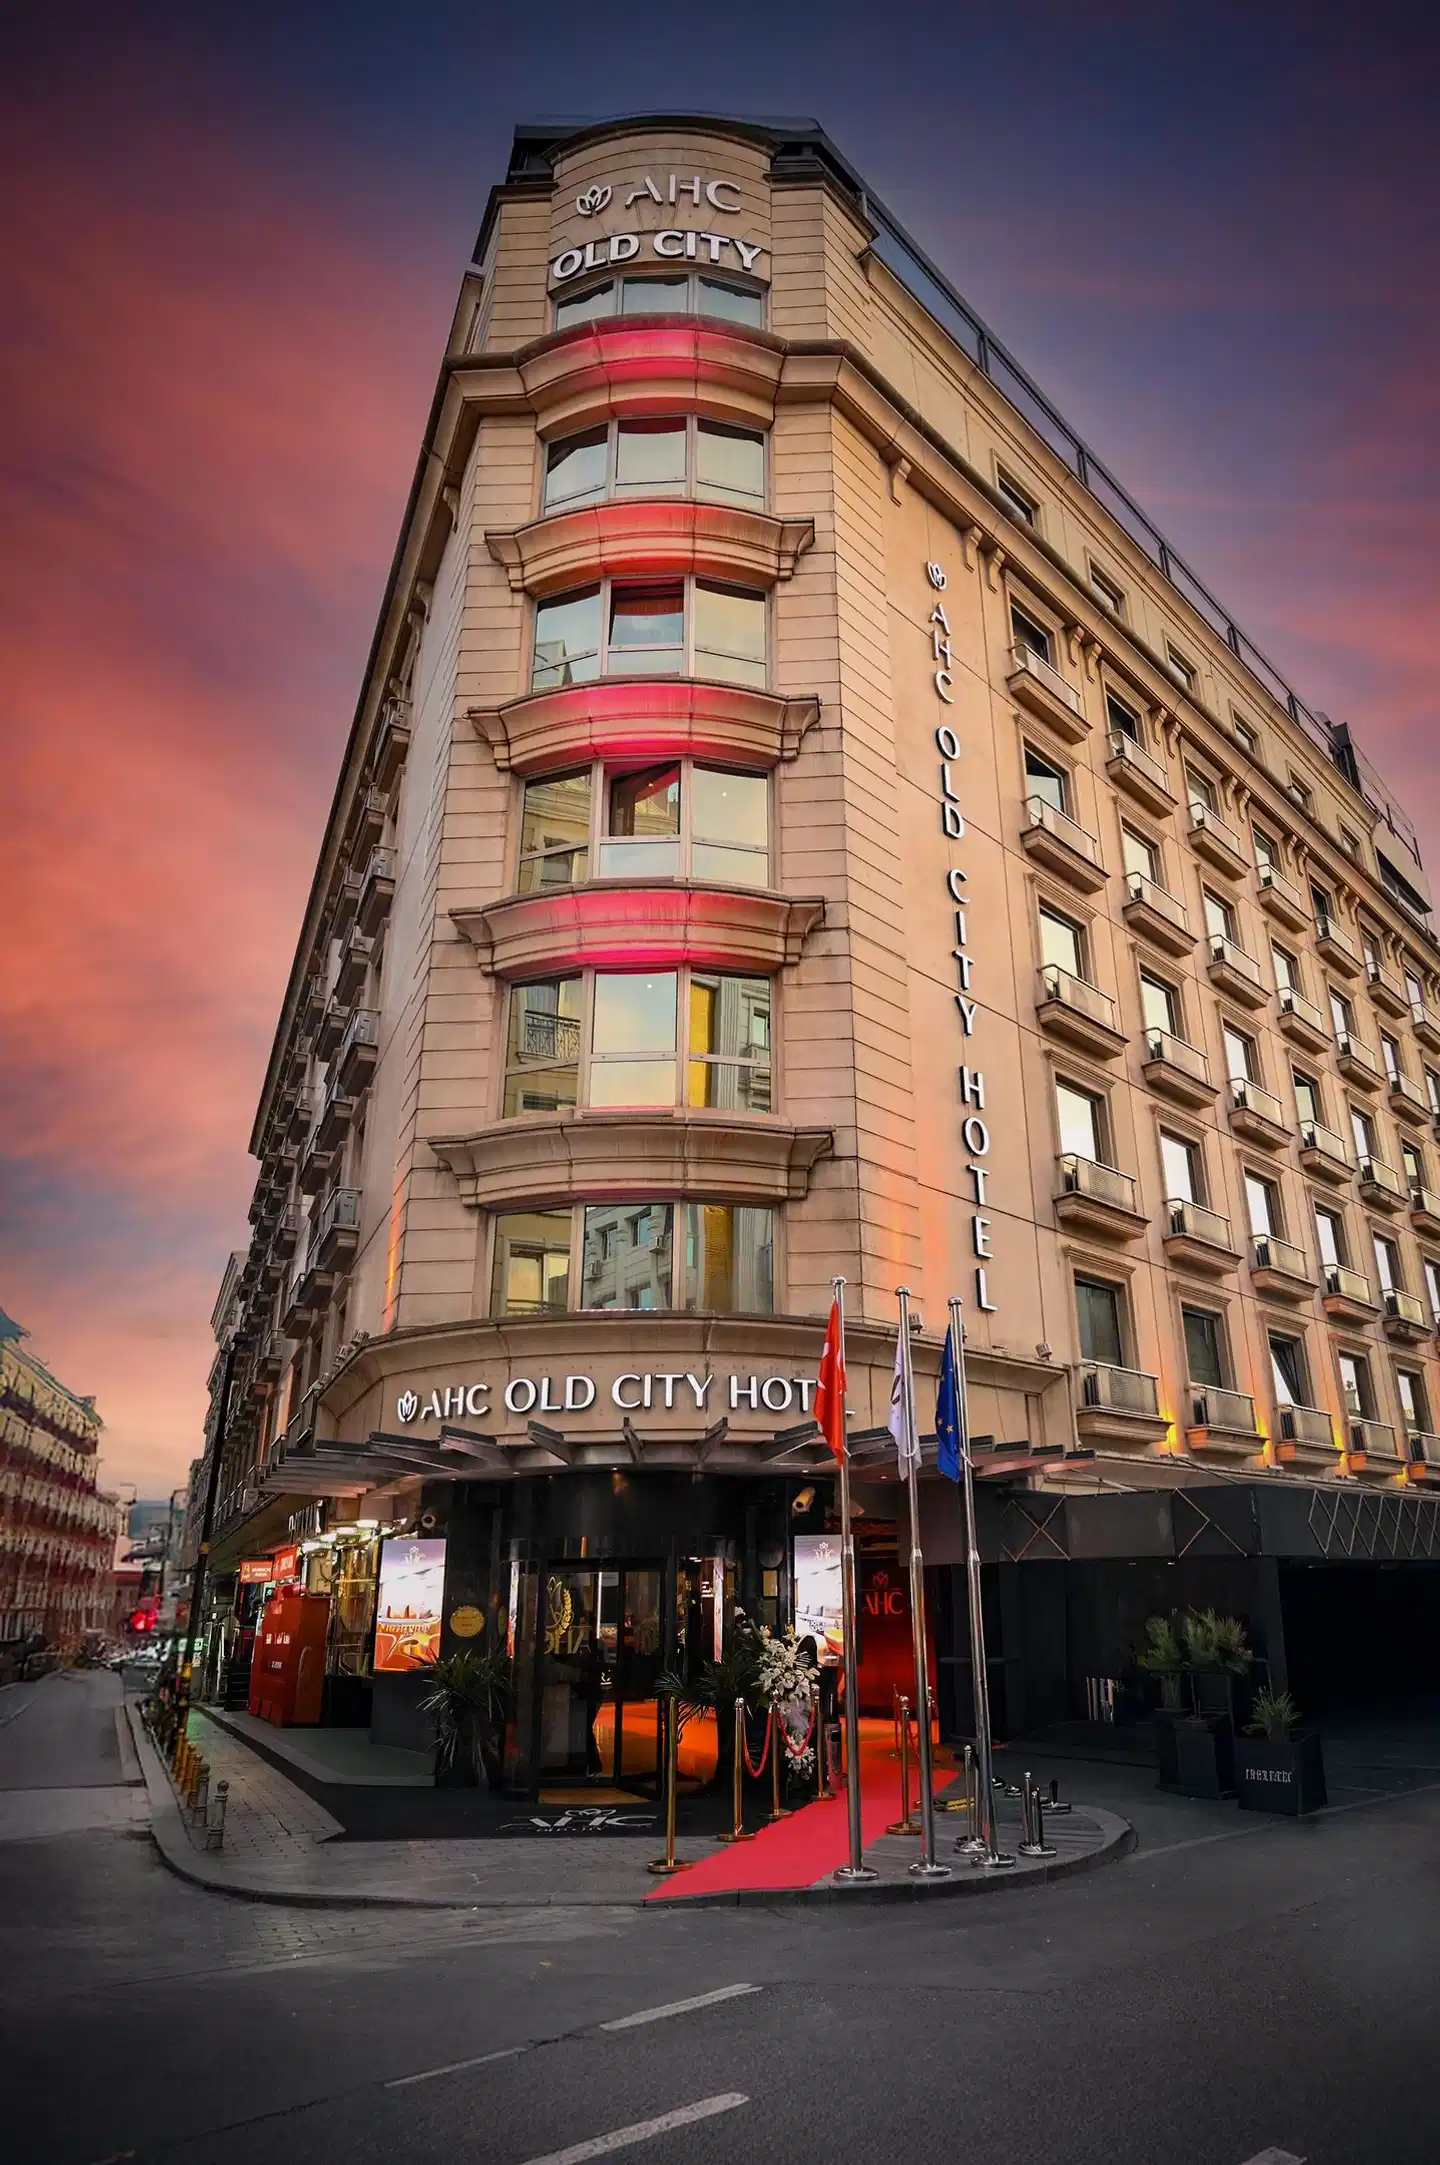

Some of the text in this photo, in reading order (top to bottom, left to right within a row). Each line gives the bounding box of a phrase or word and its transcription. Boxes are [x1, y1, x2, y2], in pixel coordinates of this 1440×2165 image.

[624, 173, 742, 214] AHC
[552, 230, 763, 280] OLD CITY
[928, 602, 998, 1312] AHC OLD CITY HOTEL
[420, 1383, 490, 1420] AHC
[504, 1374, 597, 1413] OLD
[611, 1372, 714, 1410] CITY
[729, 1374, 856, 1416] HOT
[862, 1590, 905, 1615] AHC
